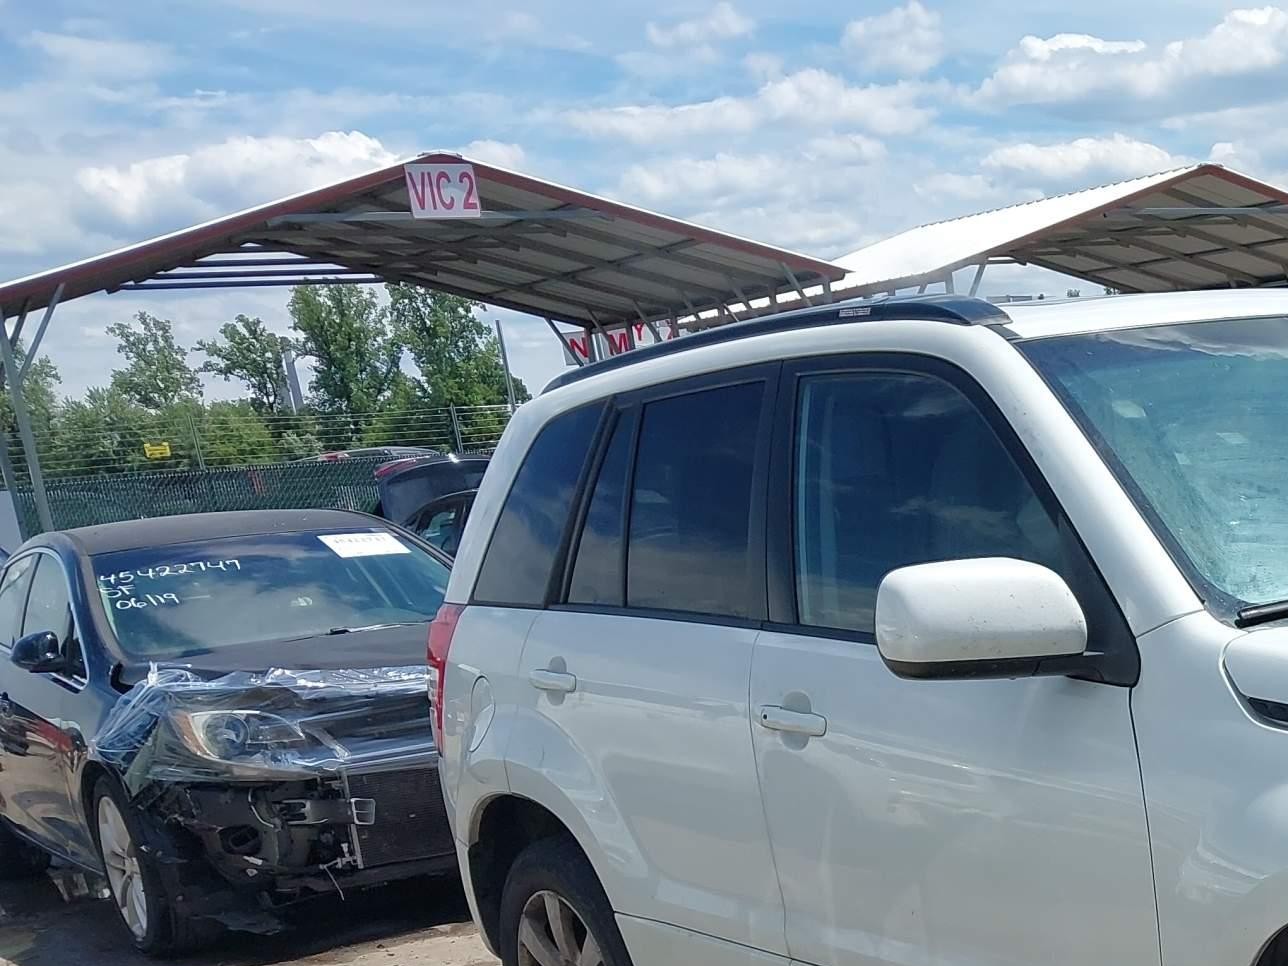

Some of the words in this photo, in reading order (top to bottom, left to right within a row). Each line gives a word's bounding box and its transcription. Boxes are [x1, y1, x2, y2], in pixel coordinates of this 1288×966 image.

[407, 170, 455, 211] VIC
[458, 171, 479, 210] 2
[569, 336, 589, 358] N
[608, 332, 630, 356] M
[99, 558, 241, 585] 45422747
